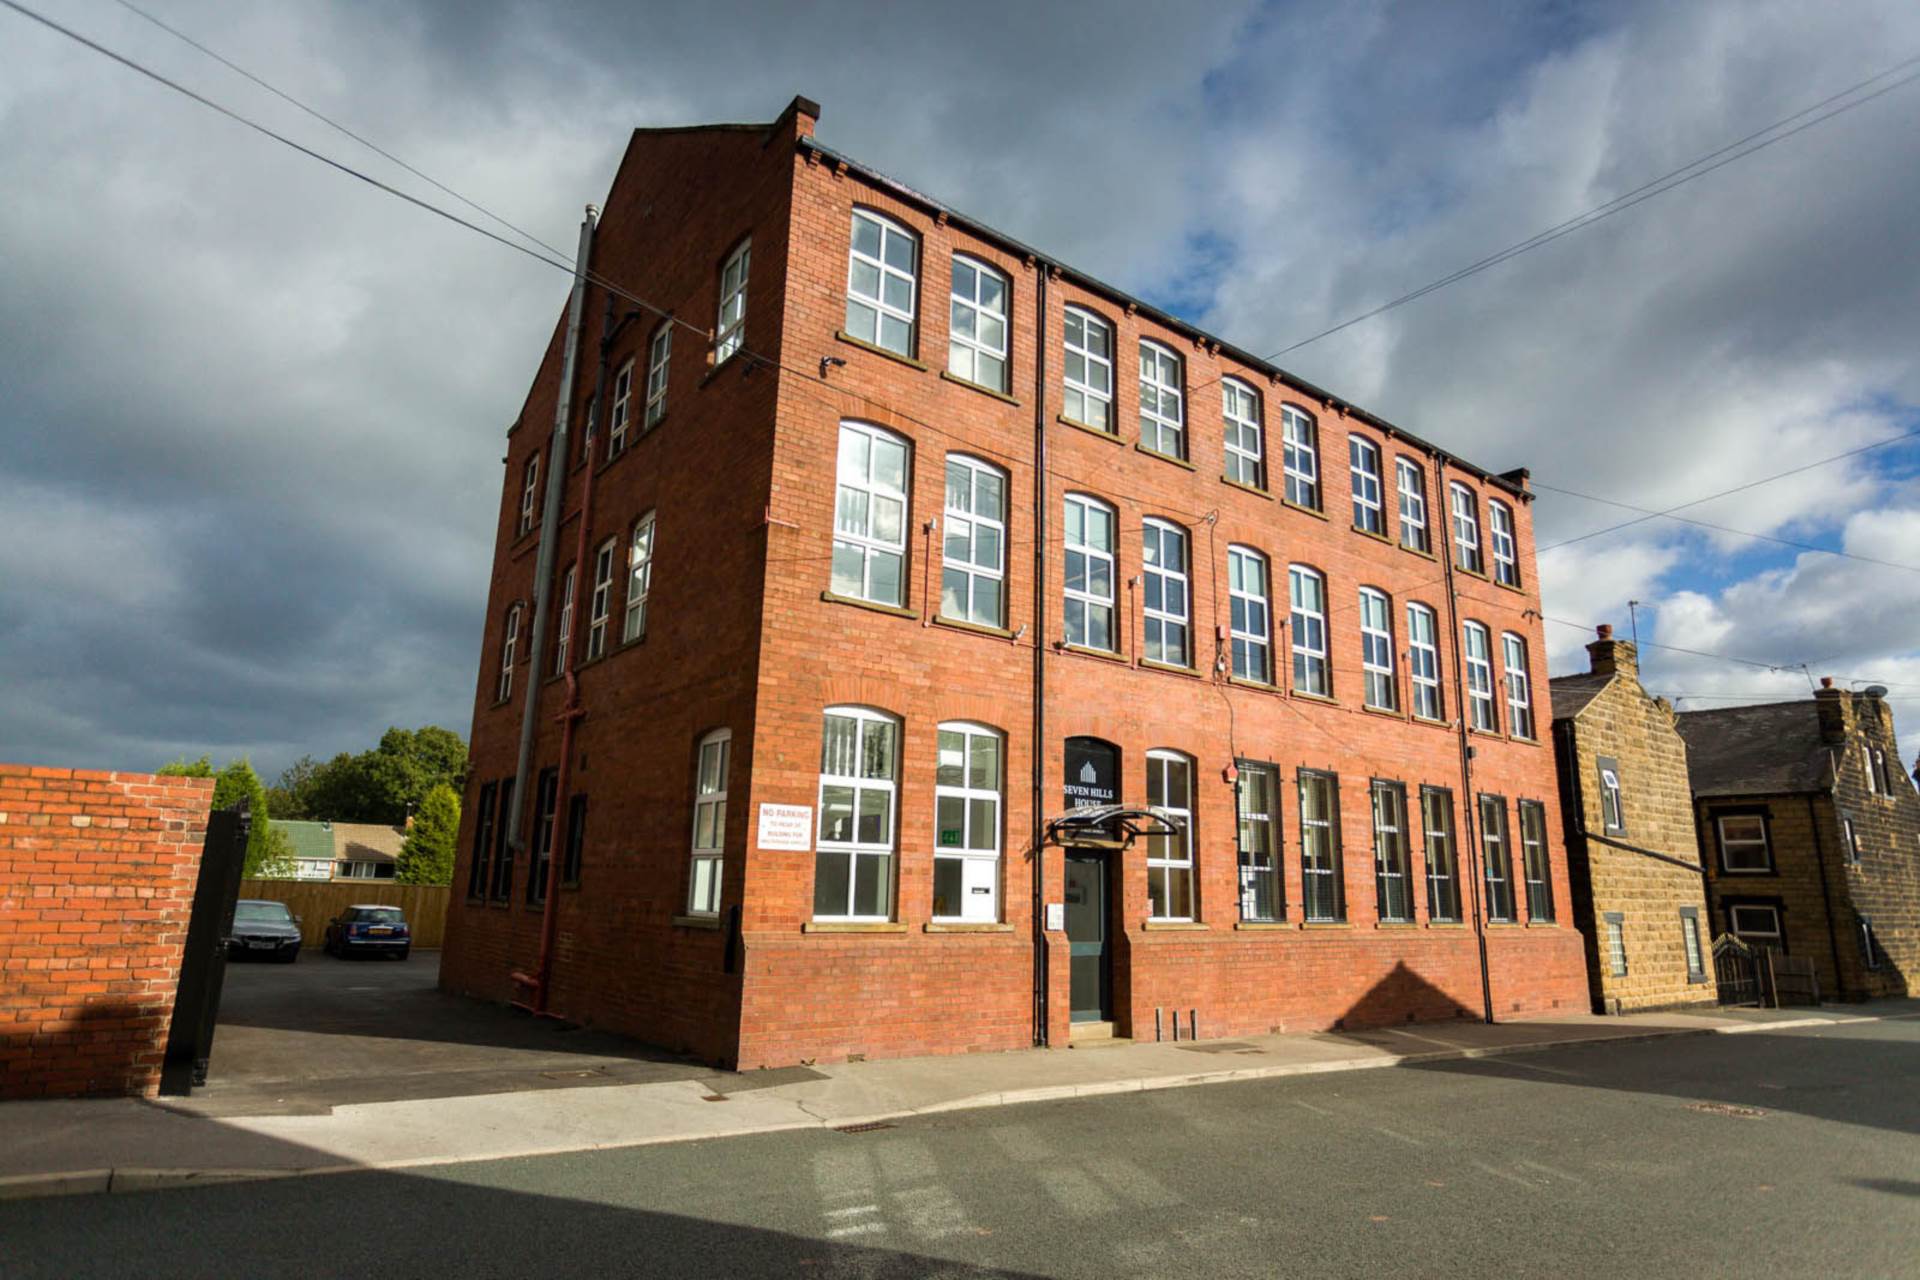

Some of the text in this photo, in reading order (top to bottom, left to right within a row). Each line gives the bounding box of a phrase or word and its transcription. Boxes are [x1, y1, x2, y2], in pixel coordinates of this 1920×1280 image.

[1063, 785, 1113, 798] SEVEN HILLS
[762, 808, 810, 819] NO PARKING
